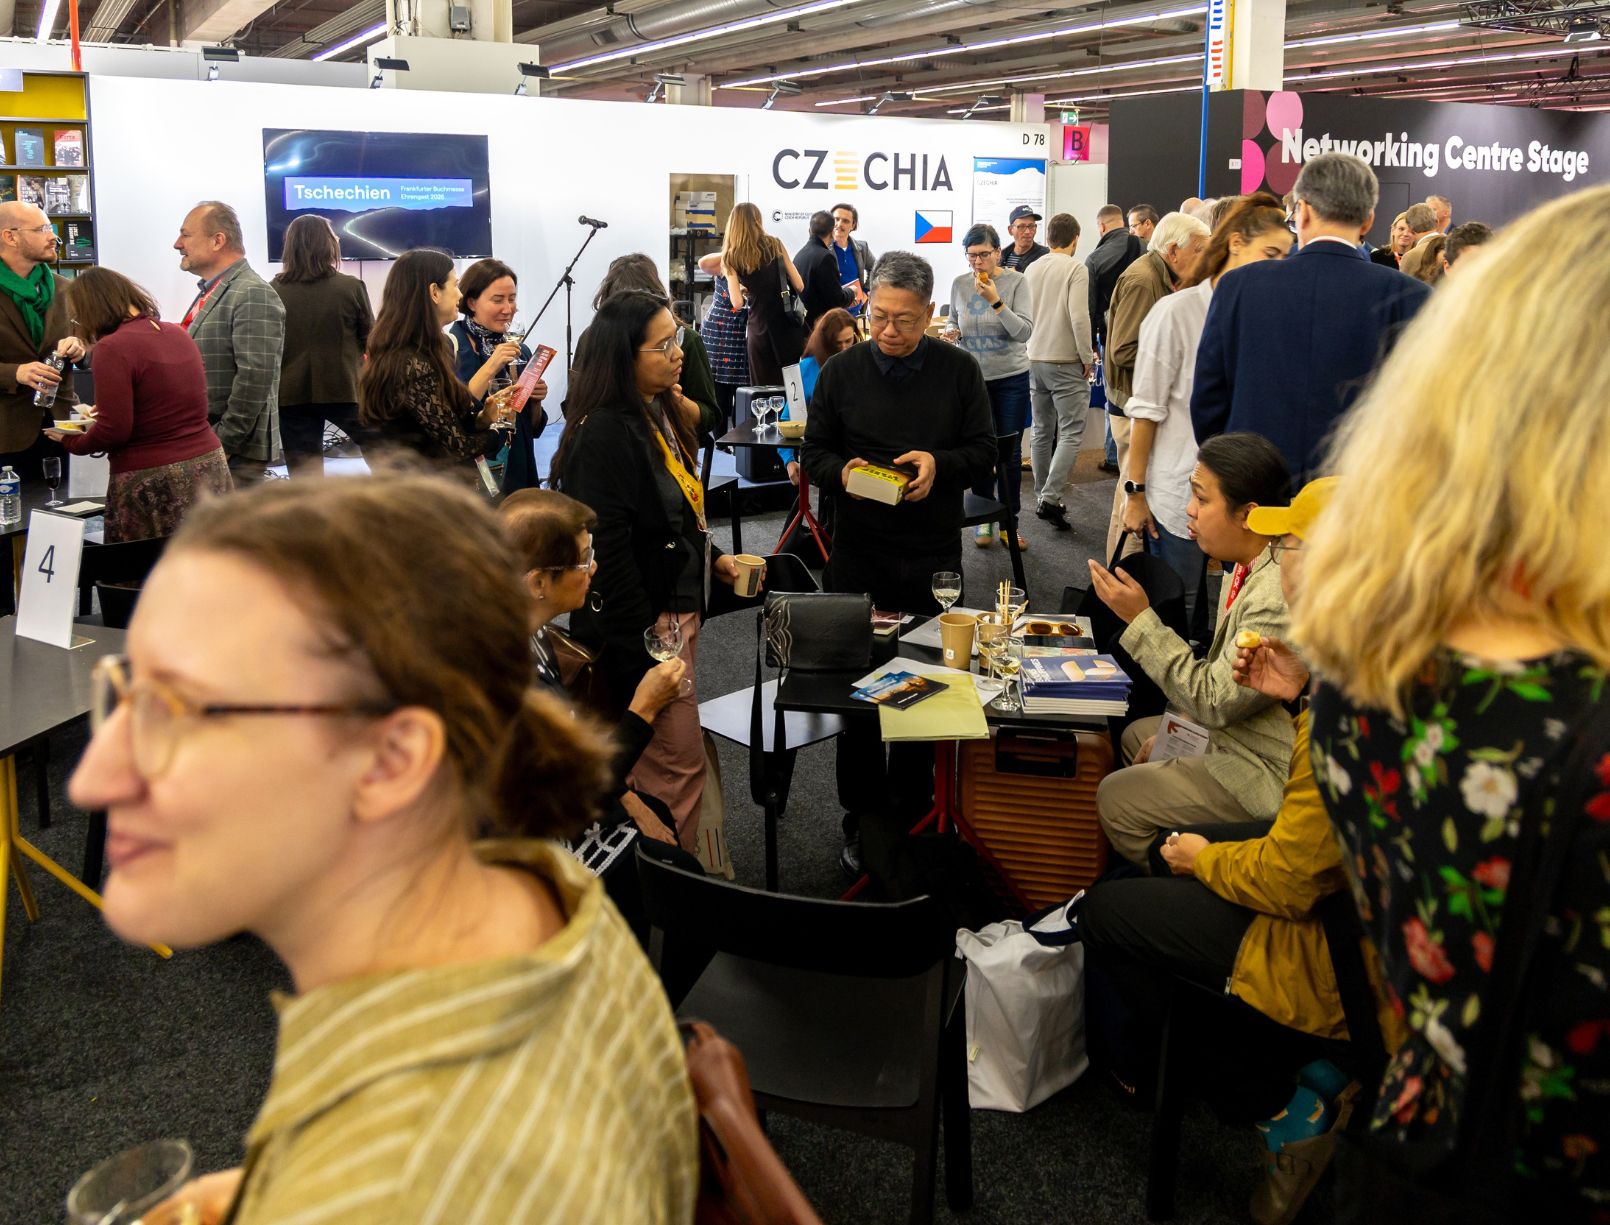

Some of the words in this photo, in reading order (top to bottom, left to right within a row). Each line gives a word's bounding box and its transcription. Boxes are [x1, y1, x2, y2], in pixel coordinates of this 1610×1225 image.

[1022, 133, 1030, 145] D
[1034, 134, 1045, 146] 78
[1072, 130, 1083, 151] B
[1281, 128, 1439, 177] Networking
[1444, 135, 1523, 172] Centre
[1526, 140, 1590, 182] Stage
[772, 148, 954, 192] CZECHIA
[293, 184, 391, 200] Tschechien
[400, 185, 432, 193] Frankfurter
[790, 381, 799, 402] 2
[38, 544, 55, 583] 4
